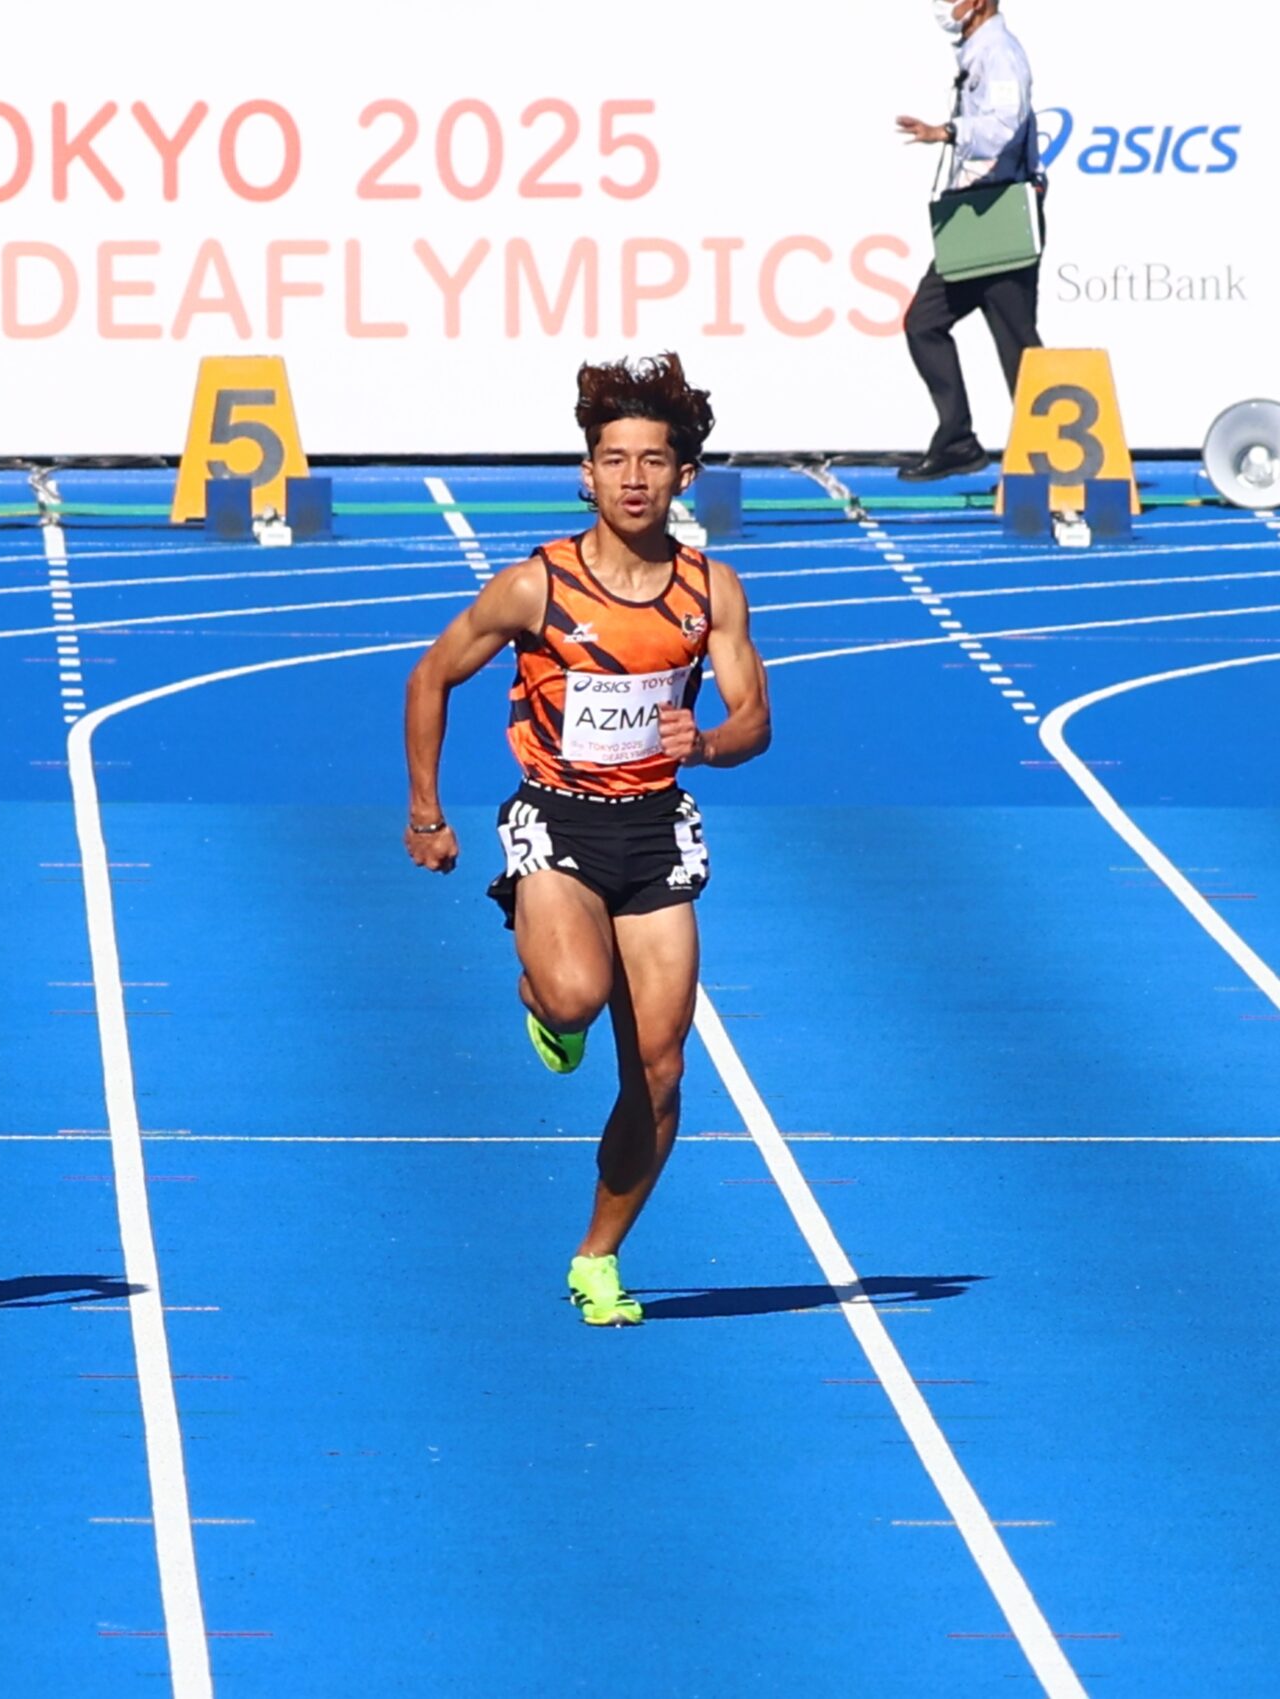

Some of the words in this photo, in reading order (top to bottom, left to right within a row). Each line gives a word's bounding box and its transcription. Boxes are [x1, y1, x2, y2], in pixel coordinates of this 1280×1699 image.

[356, 98, 660, 203] 2025
[1077, 124, 1242, 175] asics
[1, 234, 911, 340] DEAFLYMPICS
[1056, 261, 1247, 302] SoftBank
[206, 389, 285, 489] 5
[1027, 383, 1105, 487] 3
[591, 680, 632, 693] asics
[509, 825, 533, 862] 5
